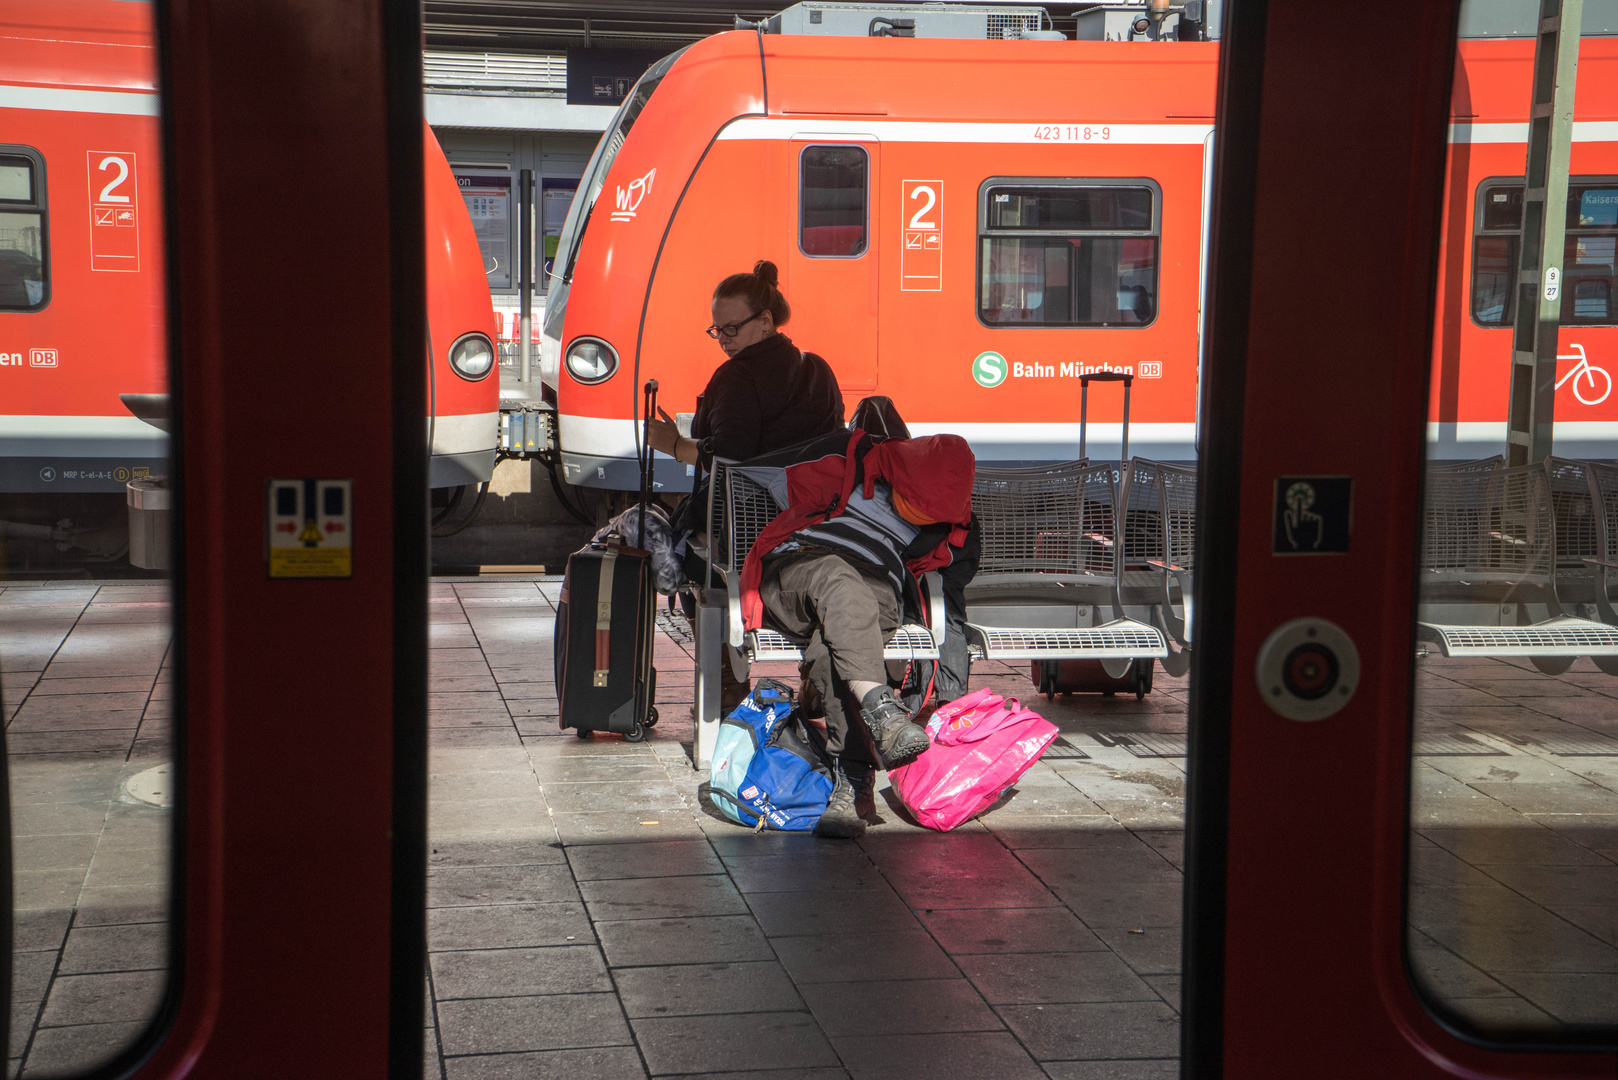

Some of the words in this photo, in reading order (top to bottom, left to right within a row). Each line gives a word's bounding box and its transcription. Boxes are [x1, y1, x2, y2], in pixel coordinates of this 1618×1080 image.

[1034, 126, 1060, 140] 423
[98, 156, 130, 203] 2
[909, 185, 936, 229] 2
[1550, 272, 1556, 281] 9
[1546, 287, 1557, 296] 27
[33, 351, 55, 365] DB
[979, 355, 1002, 384] S
[1013, 362, 1055, 378] Bahn
[1141, 364, 1160, 376] DB
[63, 470, 78, 479] MRP
[118, 470, 125, 480] D
